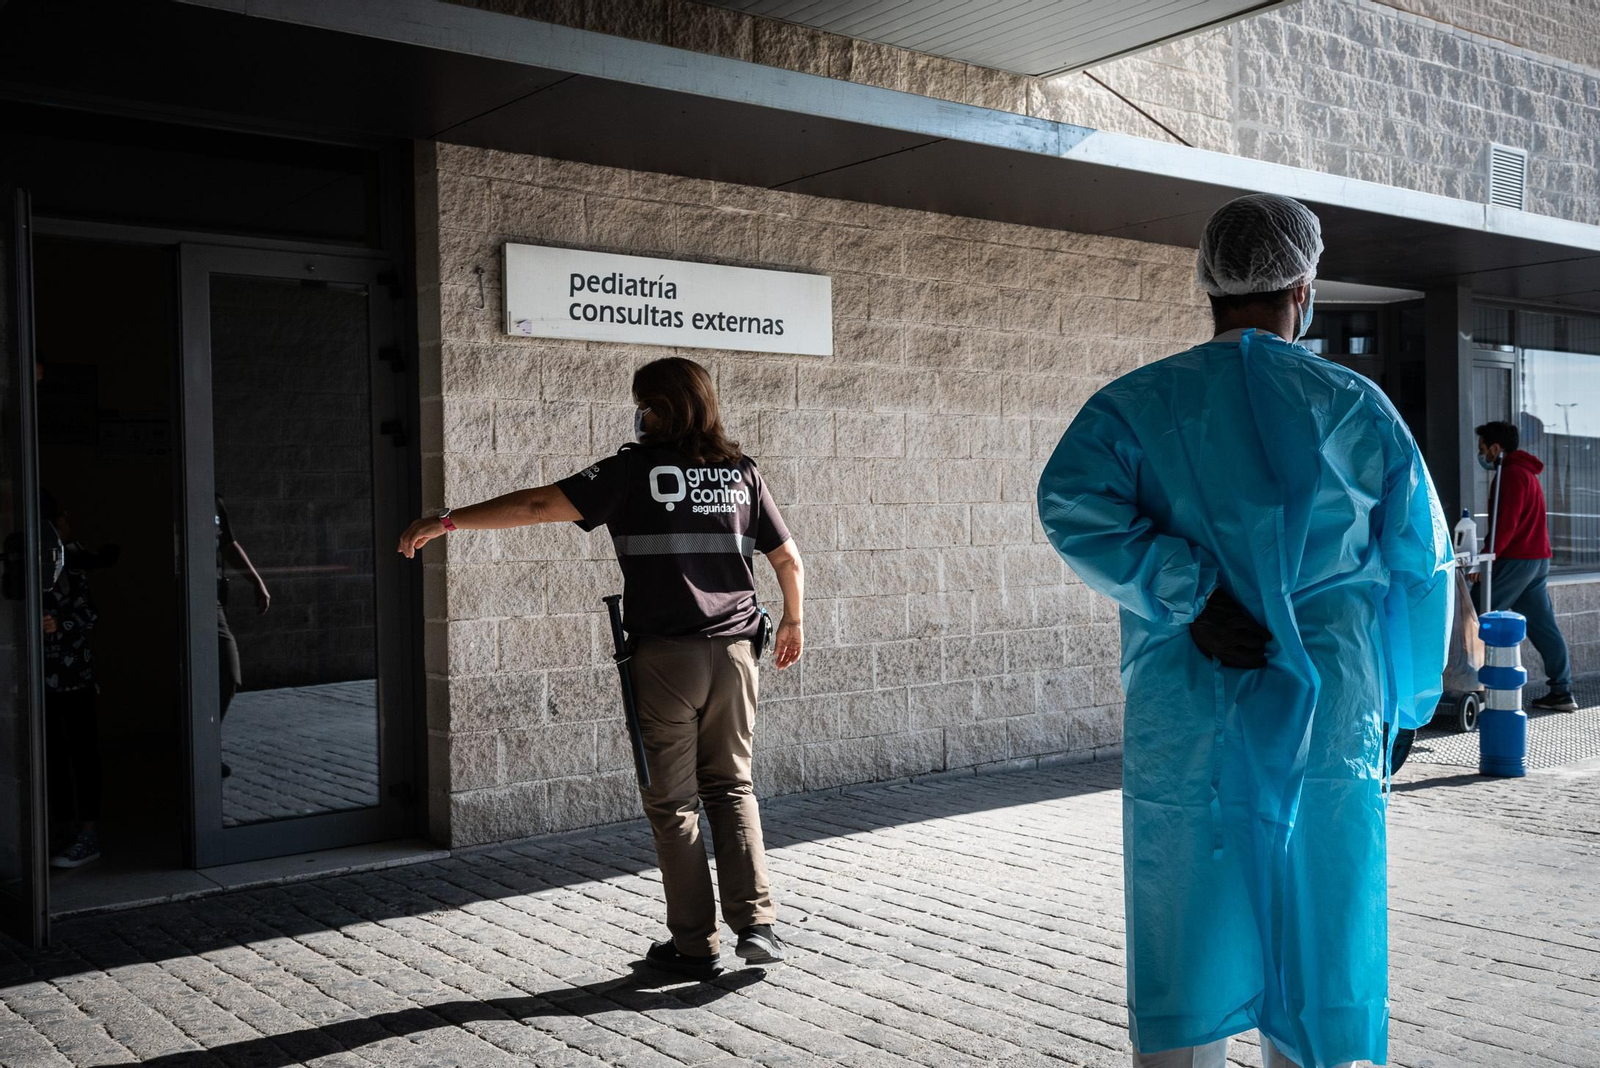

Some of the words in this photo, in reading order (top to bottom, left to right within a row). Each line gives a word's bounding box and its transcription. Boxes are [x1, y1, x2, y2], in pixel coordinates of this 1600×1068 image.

[569, 272, 677, 300] pediatría
[569, 302, 684, 329] consultas
[691, 311, 784, 336] externas
[685, 467, 742, 488] grupo
[690, 484, 751, 505] control
[692, 503, 737, 515] seguridad
